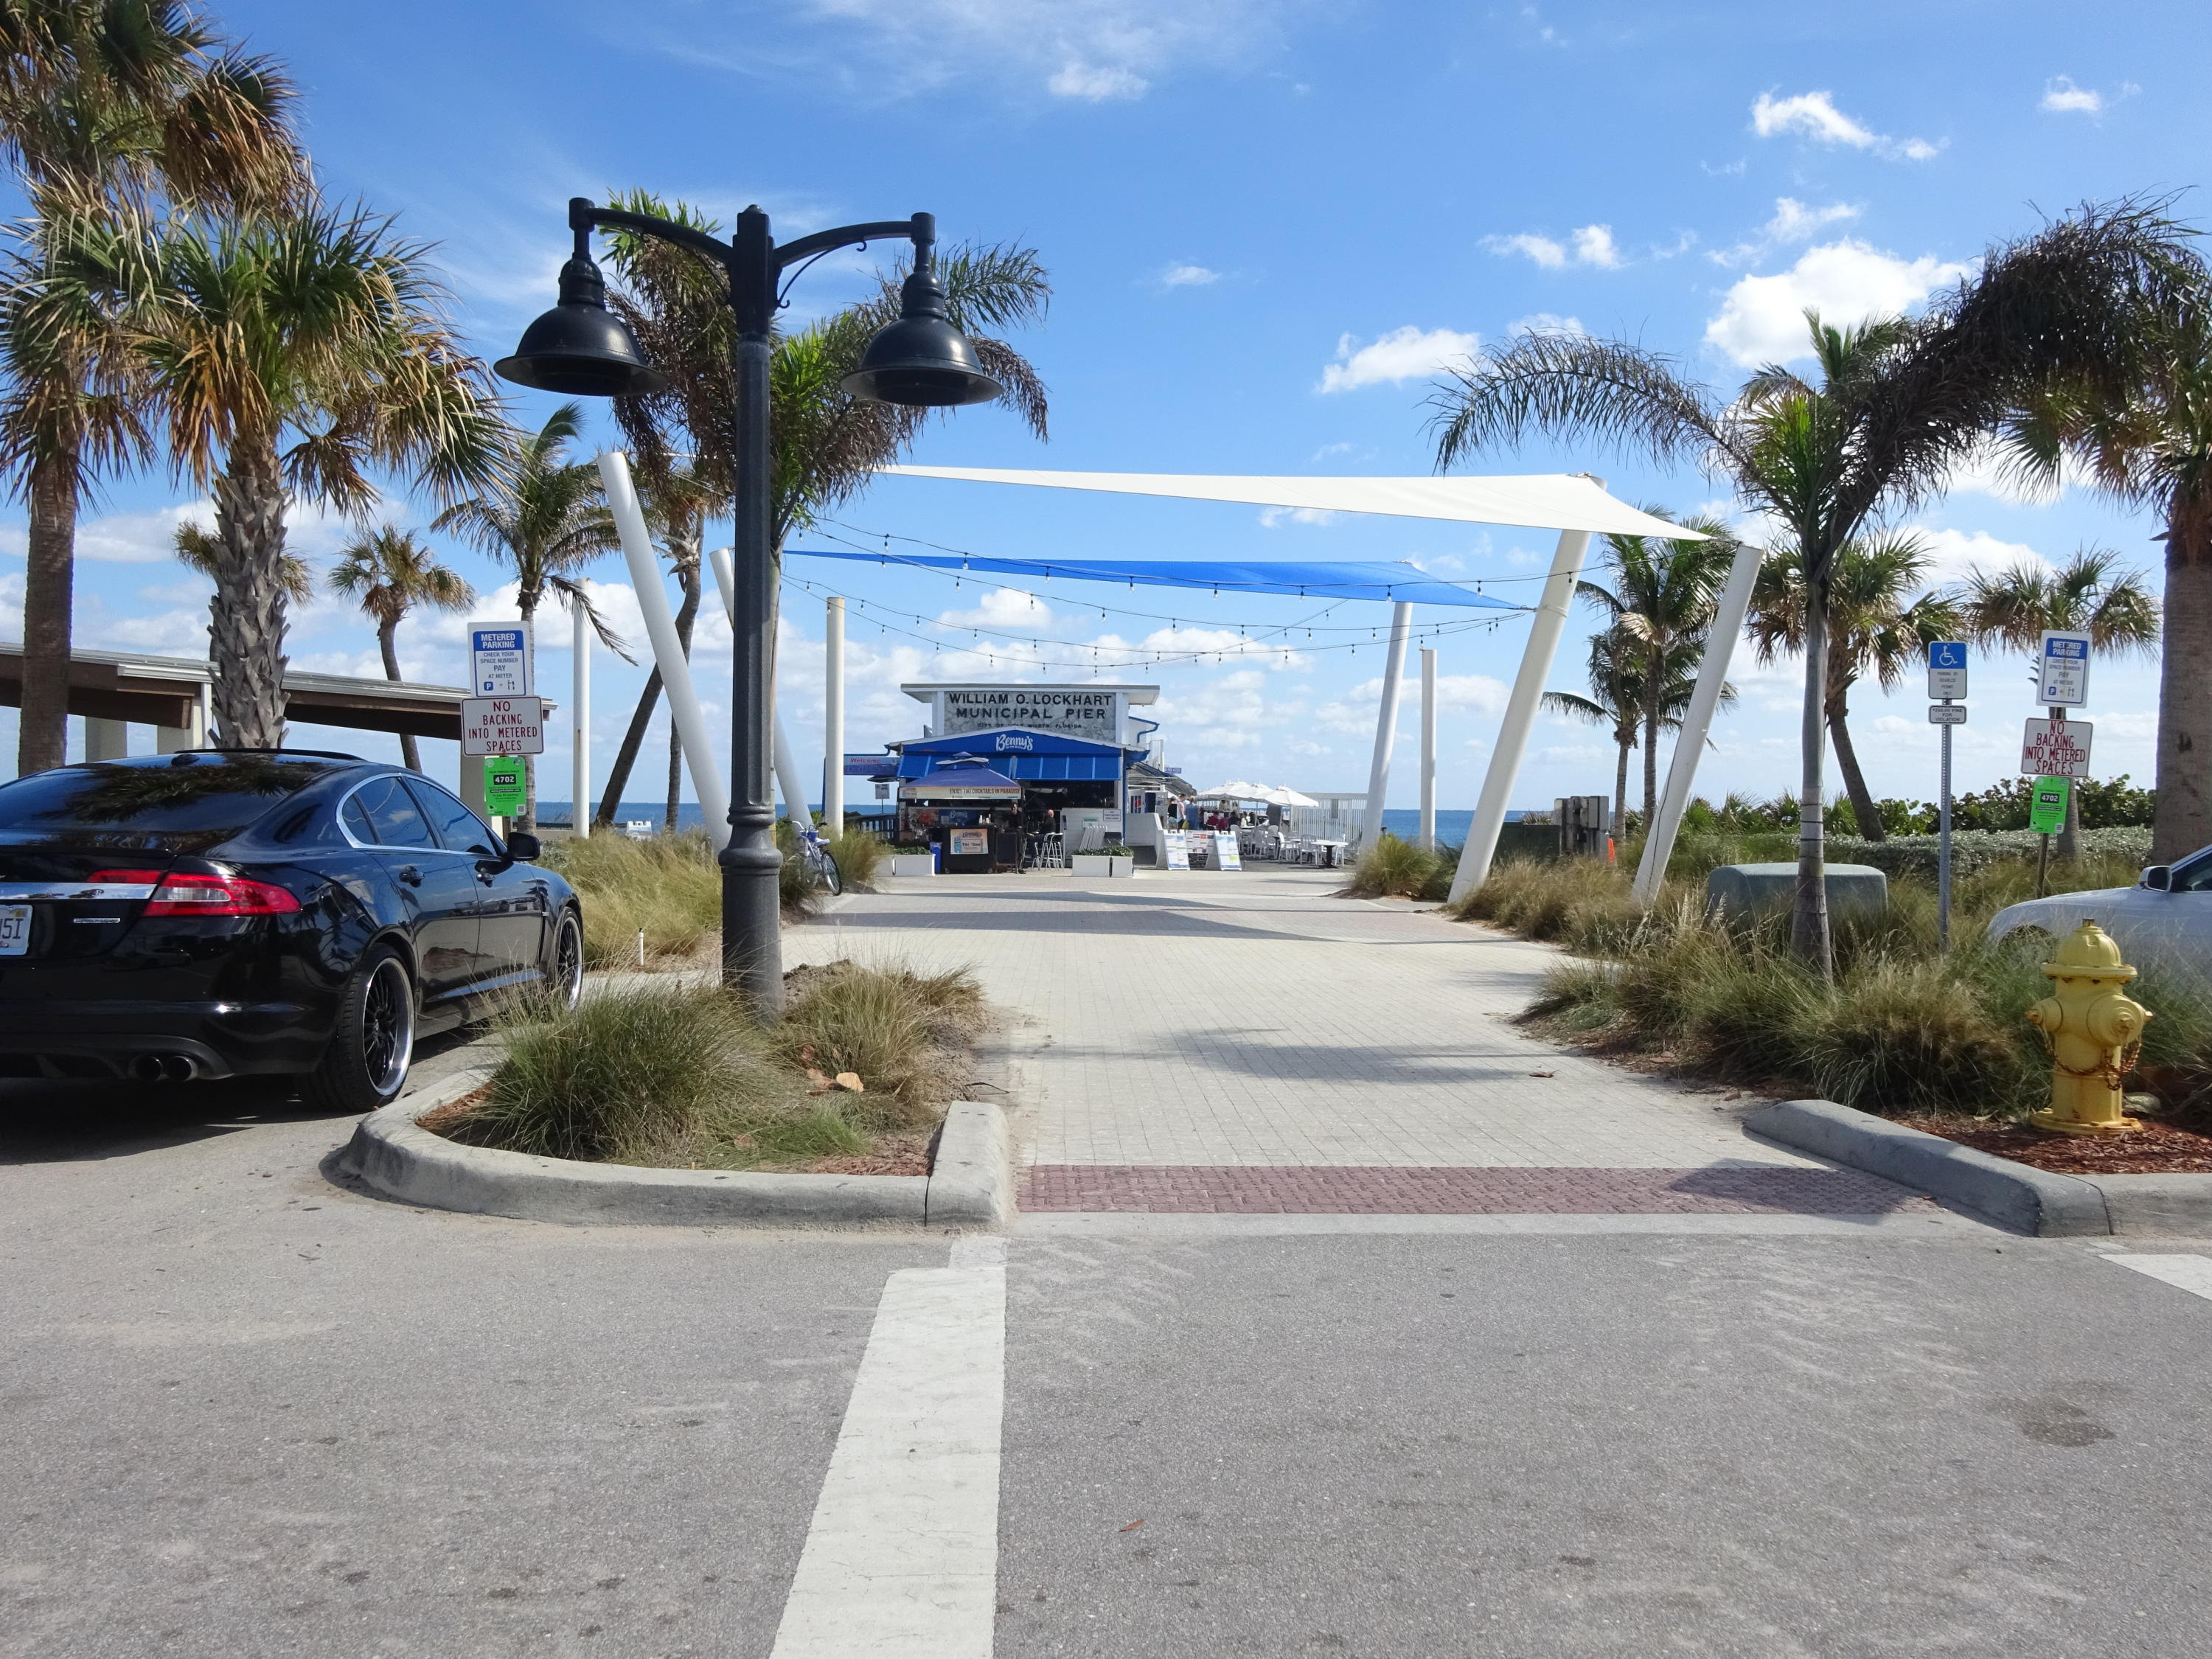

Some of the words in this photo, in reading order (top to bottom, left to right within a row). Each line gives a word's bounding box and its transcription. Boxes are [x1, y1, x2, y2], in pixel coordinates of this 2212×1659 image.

[2053, 648, 2080, 656] PARKING
[949, 693, 1009, 704] WILLIAM
[1016, 694, 1029, 705] O.
[1034, 694, 1112, 706] LOCKHART
[493, 700, 511, 712] NO
[483, 714, 523, 725] BACKING
[956, 708, 1053, 719] MUNICIPAL
[1065, 709, 1106, 720] PIER
[468, 728, 489, 739] INTO
[498, 727, 538, 738] METERED
[2050, 720, 2065, 734] NO
[487, 740, 522, 751] SPACES
[995, 734, 1033, 751] Benny's
[2036, 733, 2075, 748] BACKING
[2025, 746, 2044, 759] INTO
[2049, 748, 2085, 762] METERED
[2035, 759, 2074, 774] SPACES
